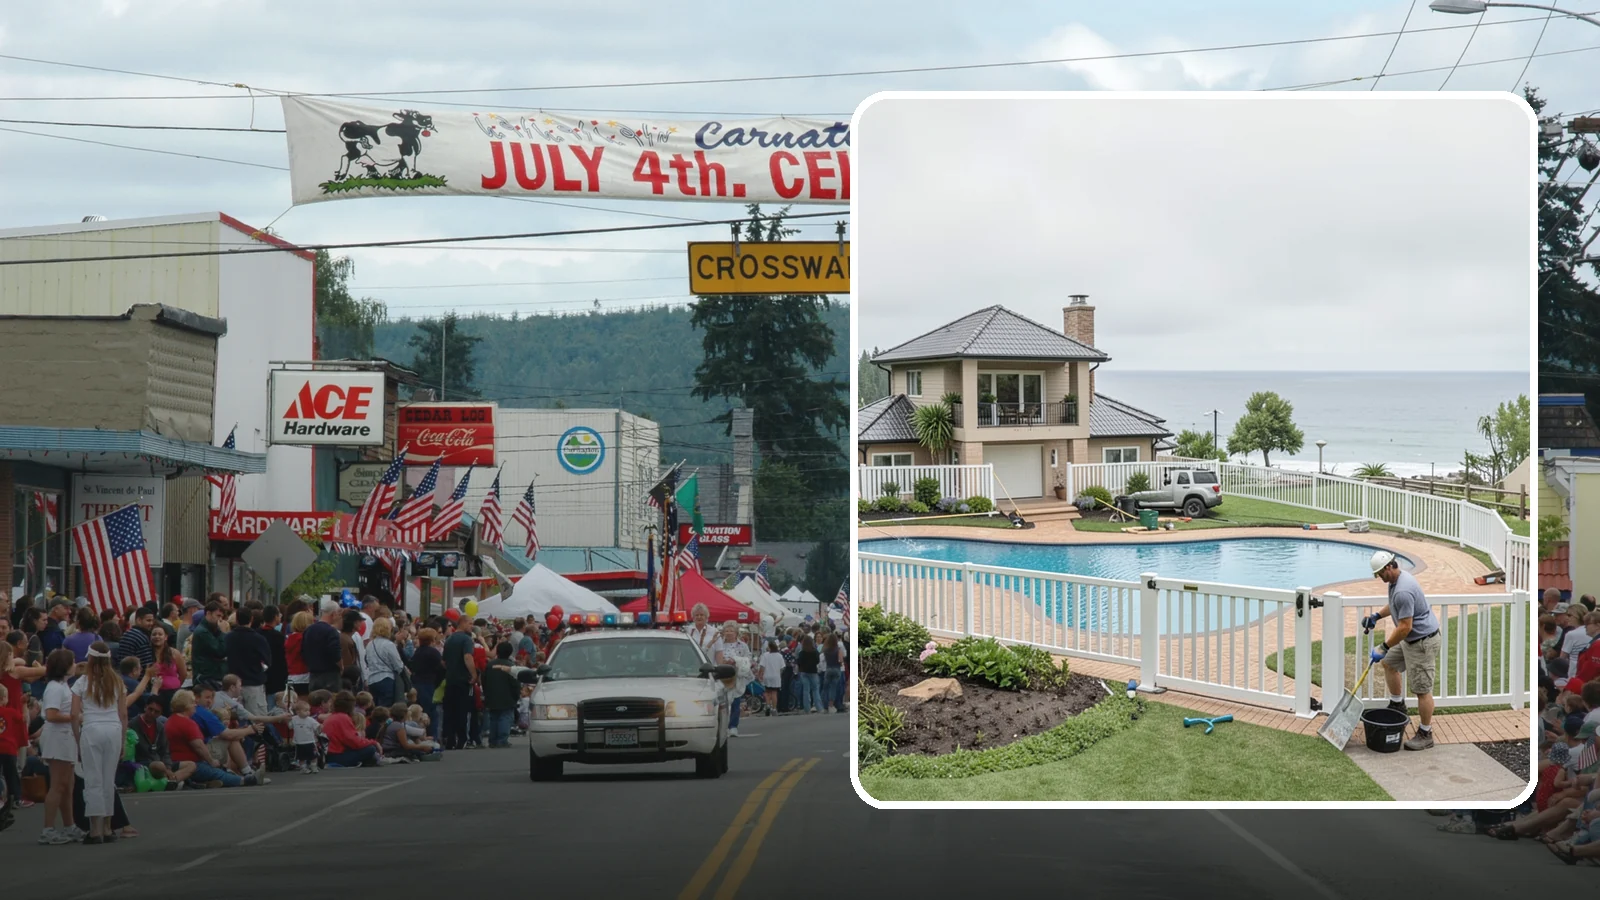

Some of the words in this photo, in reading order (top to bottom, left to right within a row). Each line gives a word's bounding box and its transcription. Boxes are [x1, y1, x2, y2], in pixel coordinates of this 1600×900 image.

[481, 140, 605, 192] JULY
[632, 150, 747, 198] 4th.
[697, 254, 850, 280] CROSSWA
[282, 380, 374, 420] ACE
[406, 409, 452, 422] CEDAR
[461, 409, 485, 422] LOG
[283, 421, 370, 437] Hardware
[416, 428, 477, 447] Coca-Cola
[353, 467, 384, 481] Simpl
[96, 486, 124, 494] Vincent
[126, 486, 136, 494] de
[138, 486, 155, 495] Paul
[81, 503, 154, 522] THT
[212, 516, 330, 536] HARDARE
[688, 526, 741, 535] CRNATION
[699, 535, 730, 543] GLASS
